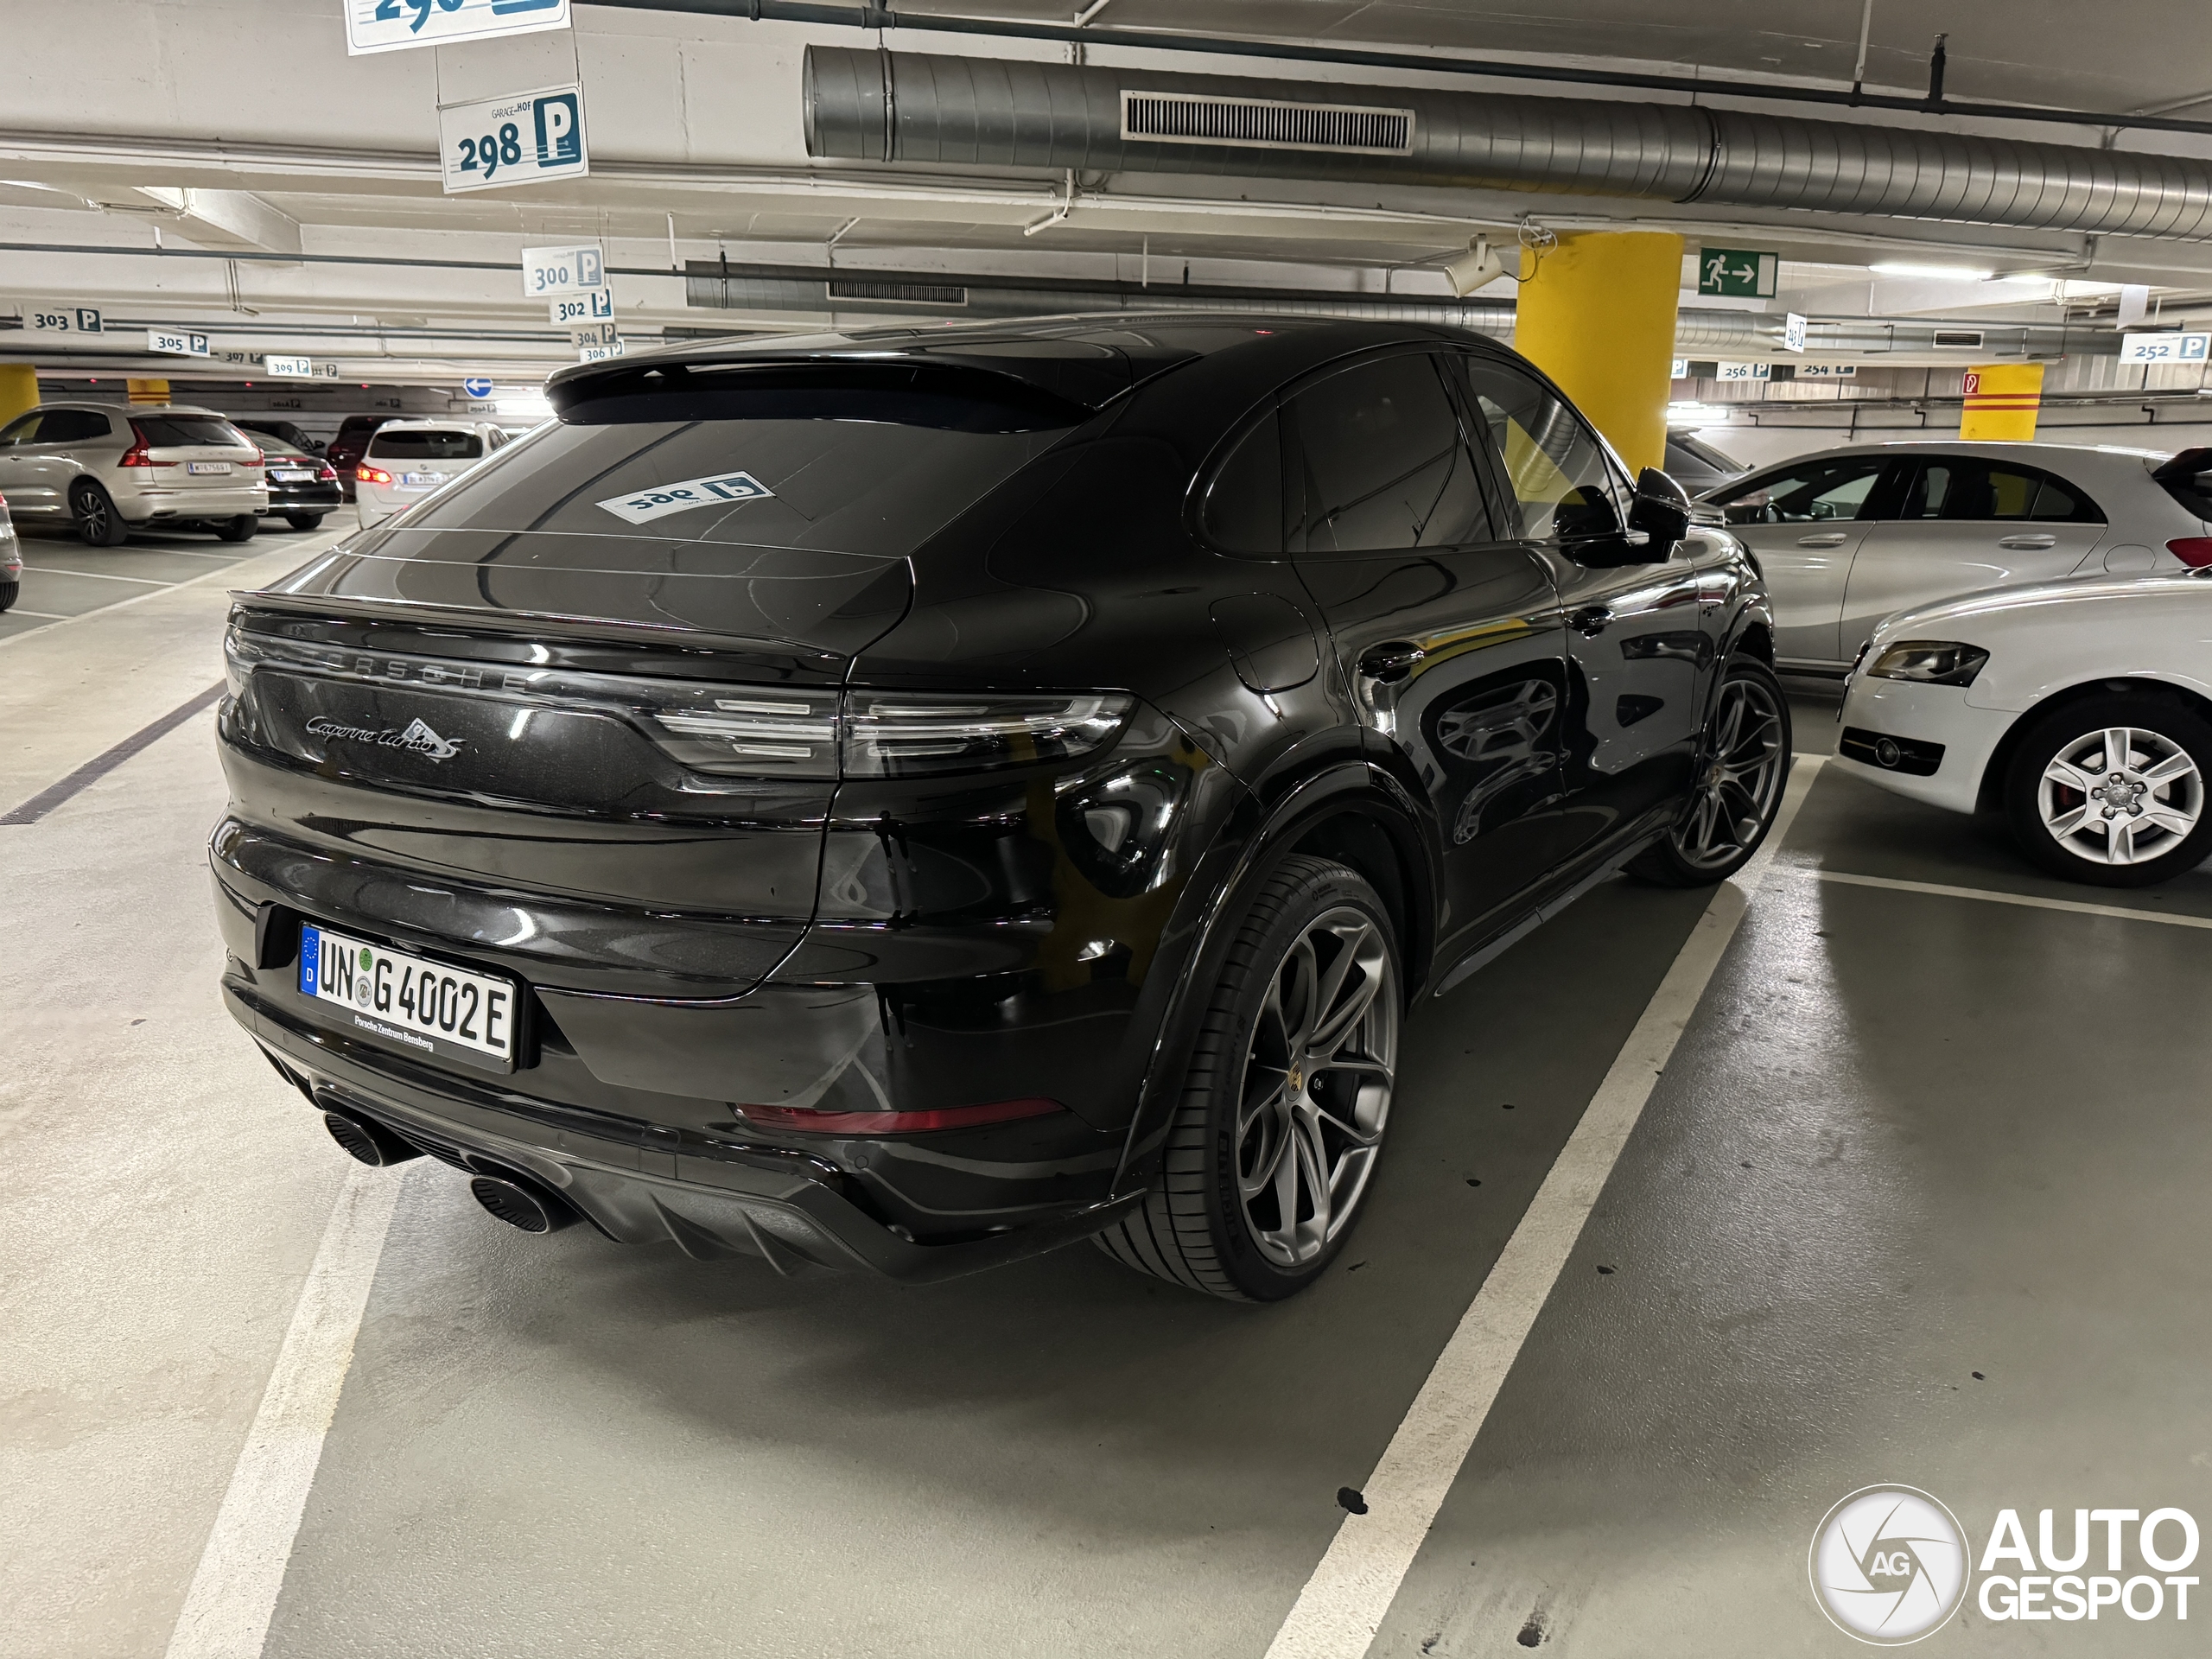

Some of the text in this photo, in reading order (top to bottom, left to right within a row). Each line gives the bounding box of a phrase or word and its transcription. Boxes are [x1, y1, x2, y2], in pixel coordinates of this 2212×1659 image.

[458, 102, 572, 180] 298 P
[535, 253, 597, 291] 300 P
[559, 291, 608, 321] 302 P
[35, 310, 97, 331] 303 P
[158, 335, 206, 351] 305 P
[577, 332, 598, 346] 304
[587, 347, 605, 361] 306
[2135, 338, 2203, 360] 252 P
[226, 352, 245, 363] 307
[274, 364, 293, 373] 309
[1726, 365, 1747, 378] 256
[1803, 365, 1828, 375] 254
[306, 967, 314, 983] D
[321, 939, 354, 1001] UN
[373, 958, 392, 1013] G
[398, 966, 506, 1049] 4002E
[354, 1014, 434, 1052] Porsche Zentrum Bensberg
